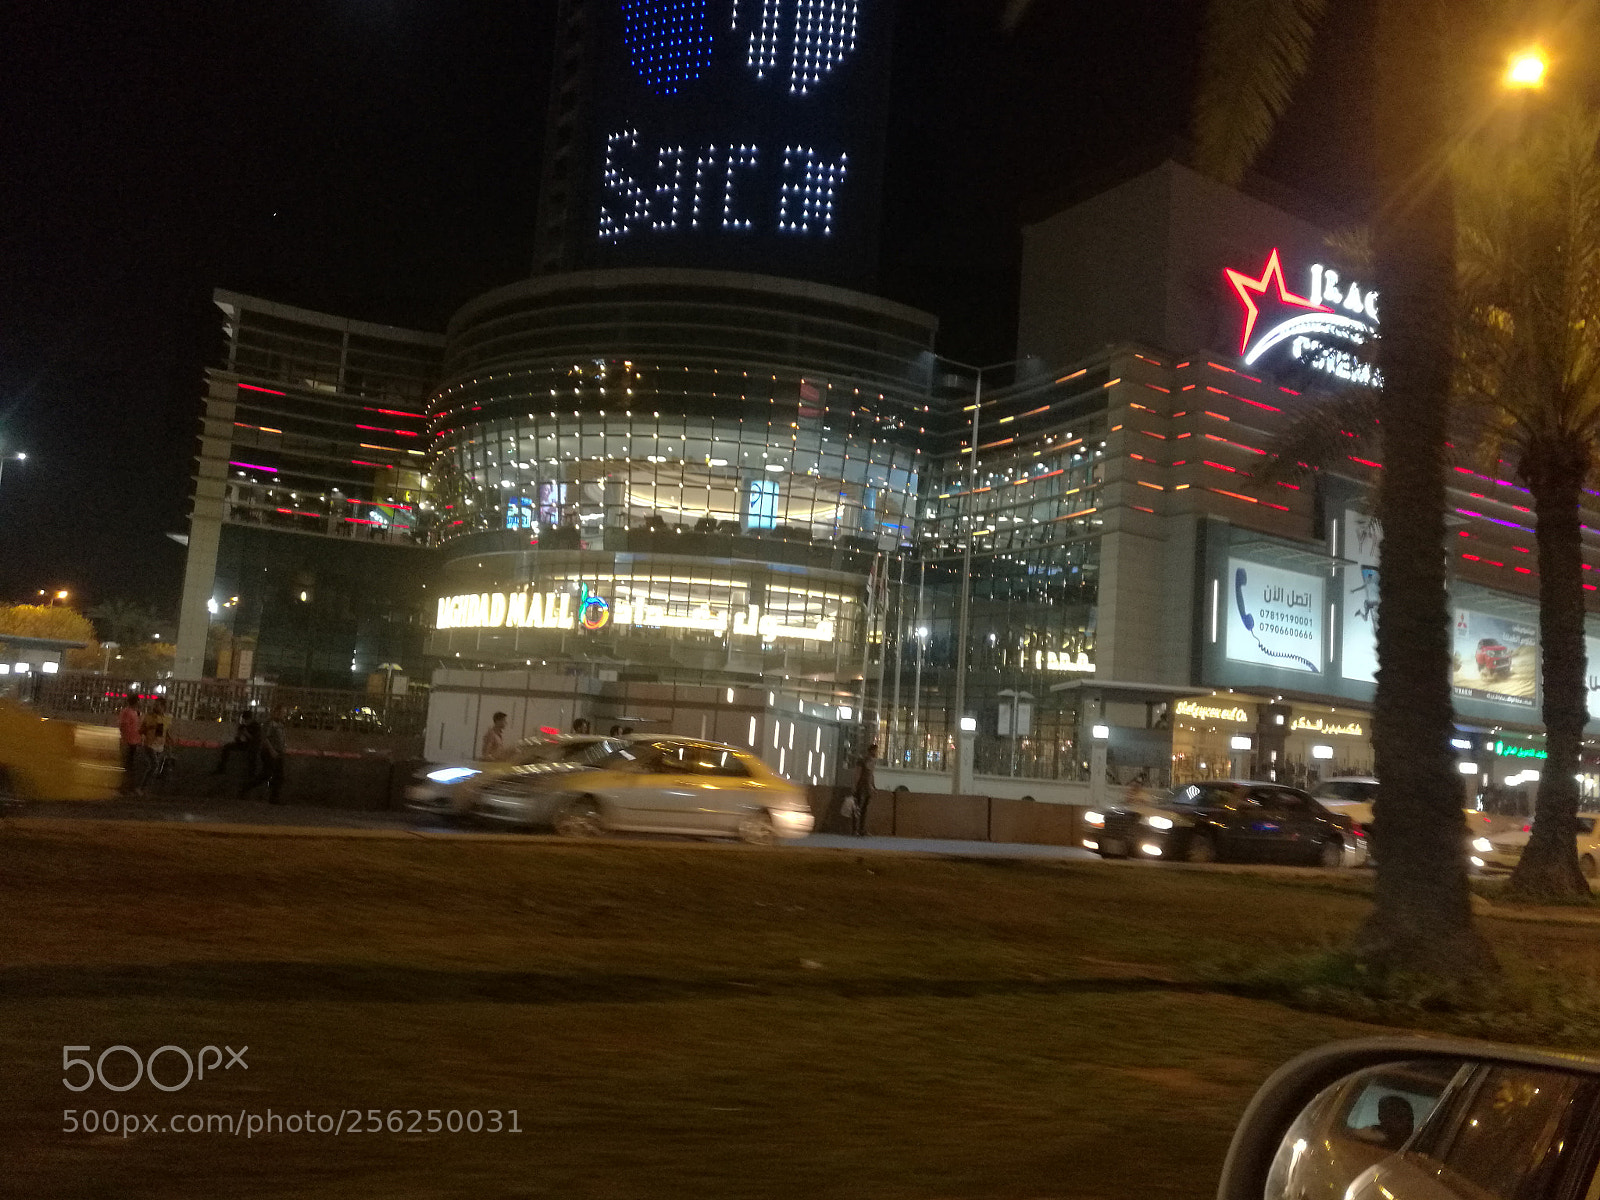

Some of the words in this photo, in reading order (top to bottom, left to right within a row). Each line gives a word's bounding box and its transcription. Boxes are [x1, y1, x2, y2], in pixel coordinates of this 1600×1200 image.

[506, 592, 575, 630] MALL
[1259, 608, 1313, 628] 07819190001
[1259, 622, 1313, 641] 07906600666
